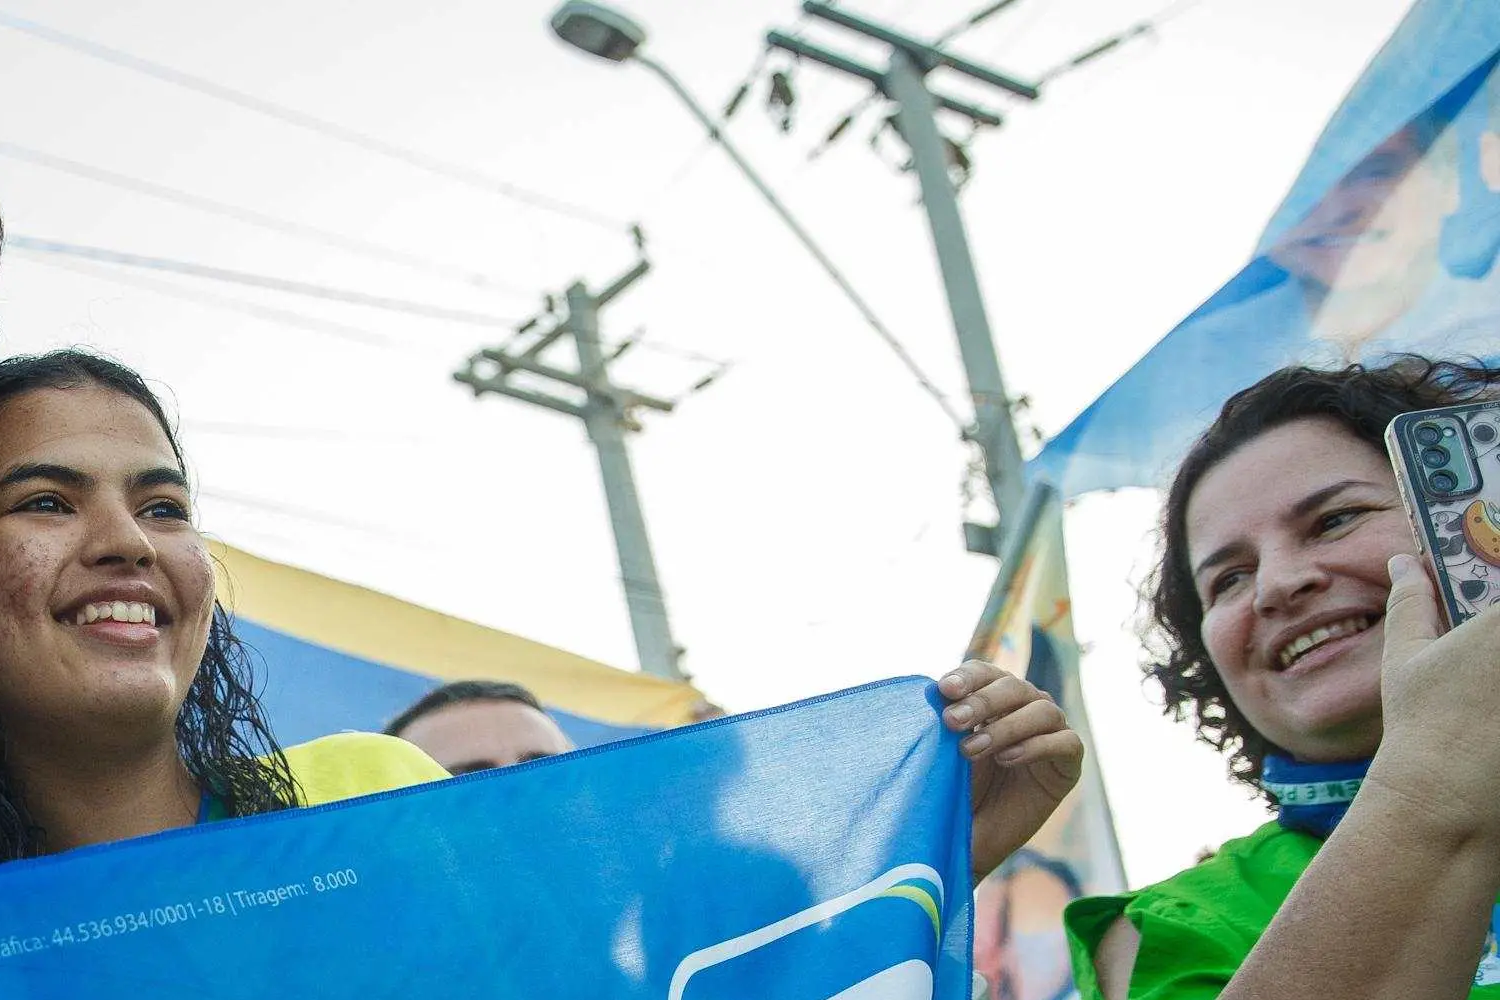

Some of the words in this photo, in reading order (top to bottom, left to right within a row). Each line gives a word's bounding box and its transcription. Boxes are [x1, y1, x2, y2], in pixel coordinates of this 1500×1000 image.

[52, 896, 226, 947] 44.536.934/0001-18
[233, 881, 309, 909] Tiragem:
[312, 868, 359, 893] 8.000
